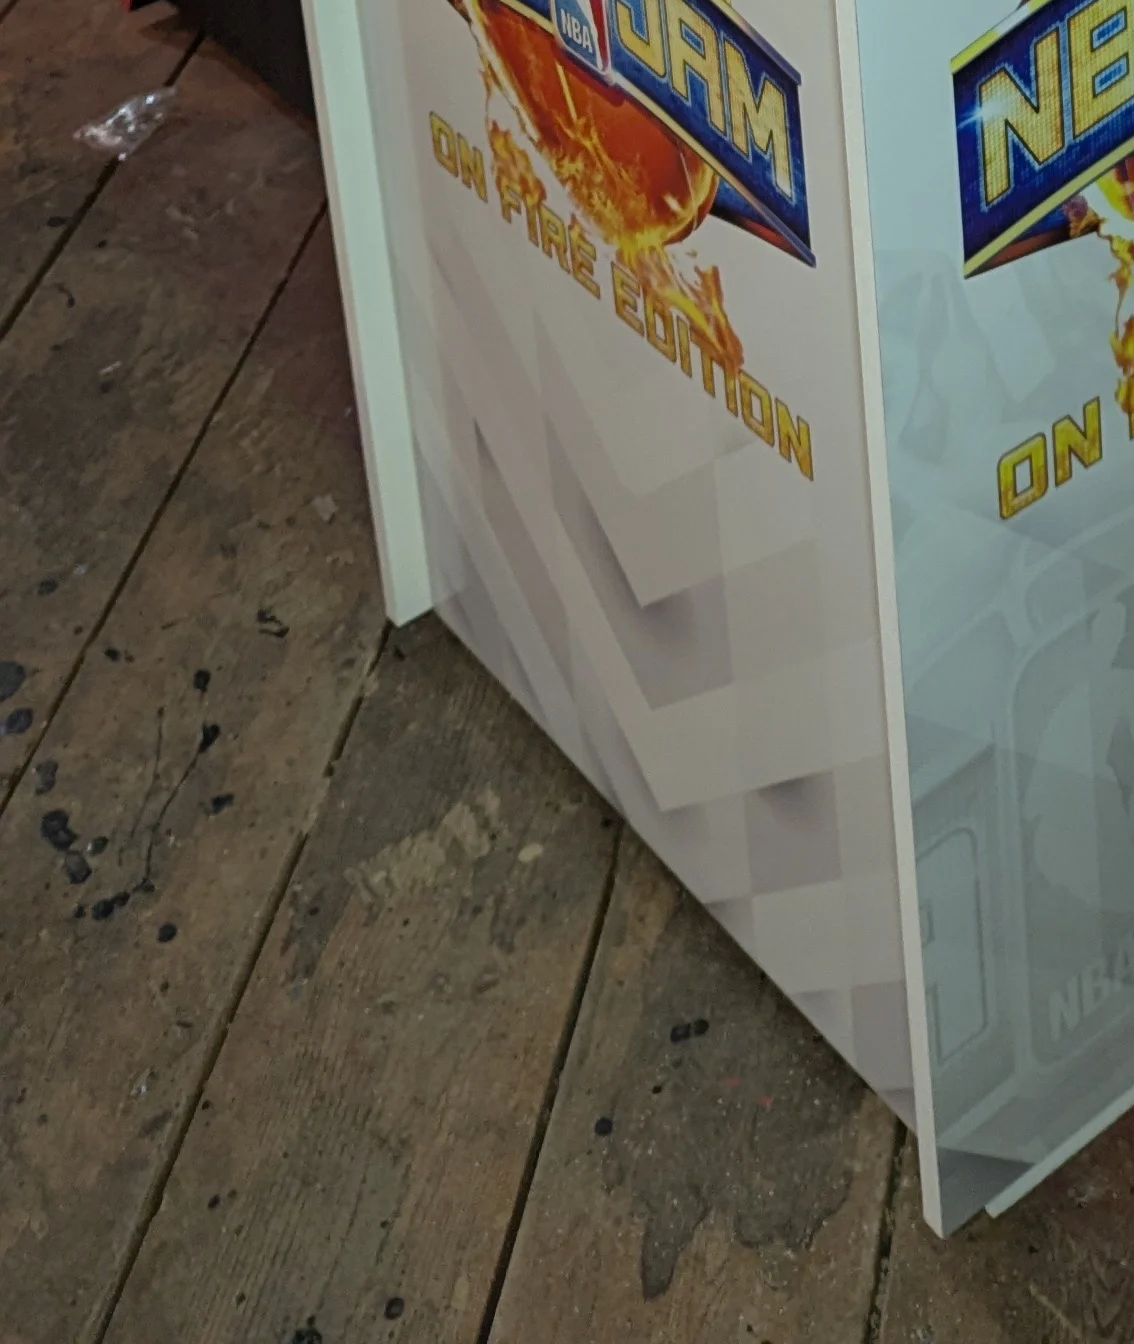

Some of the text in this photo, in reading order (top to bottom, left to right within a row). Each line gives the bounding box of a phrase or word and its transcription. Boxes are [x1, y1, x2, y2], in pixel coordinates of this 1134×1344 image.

[560, 8, 595, 54] NBA
[429, 110, 814, 482] ON FIRE EDITION
[996, 396, 1103, 520] ON
